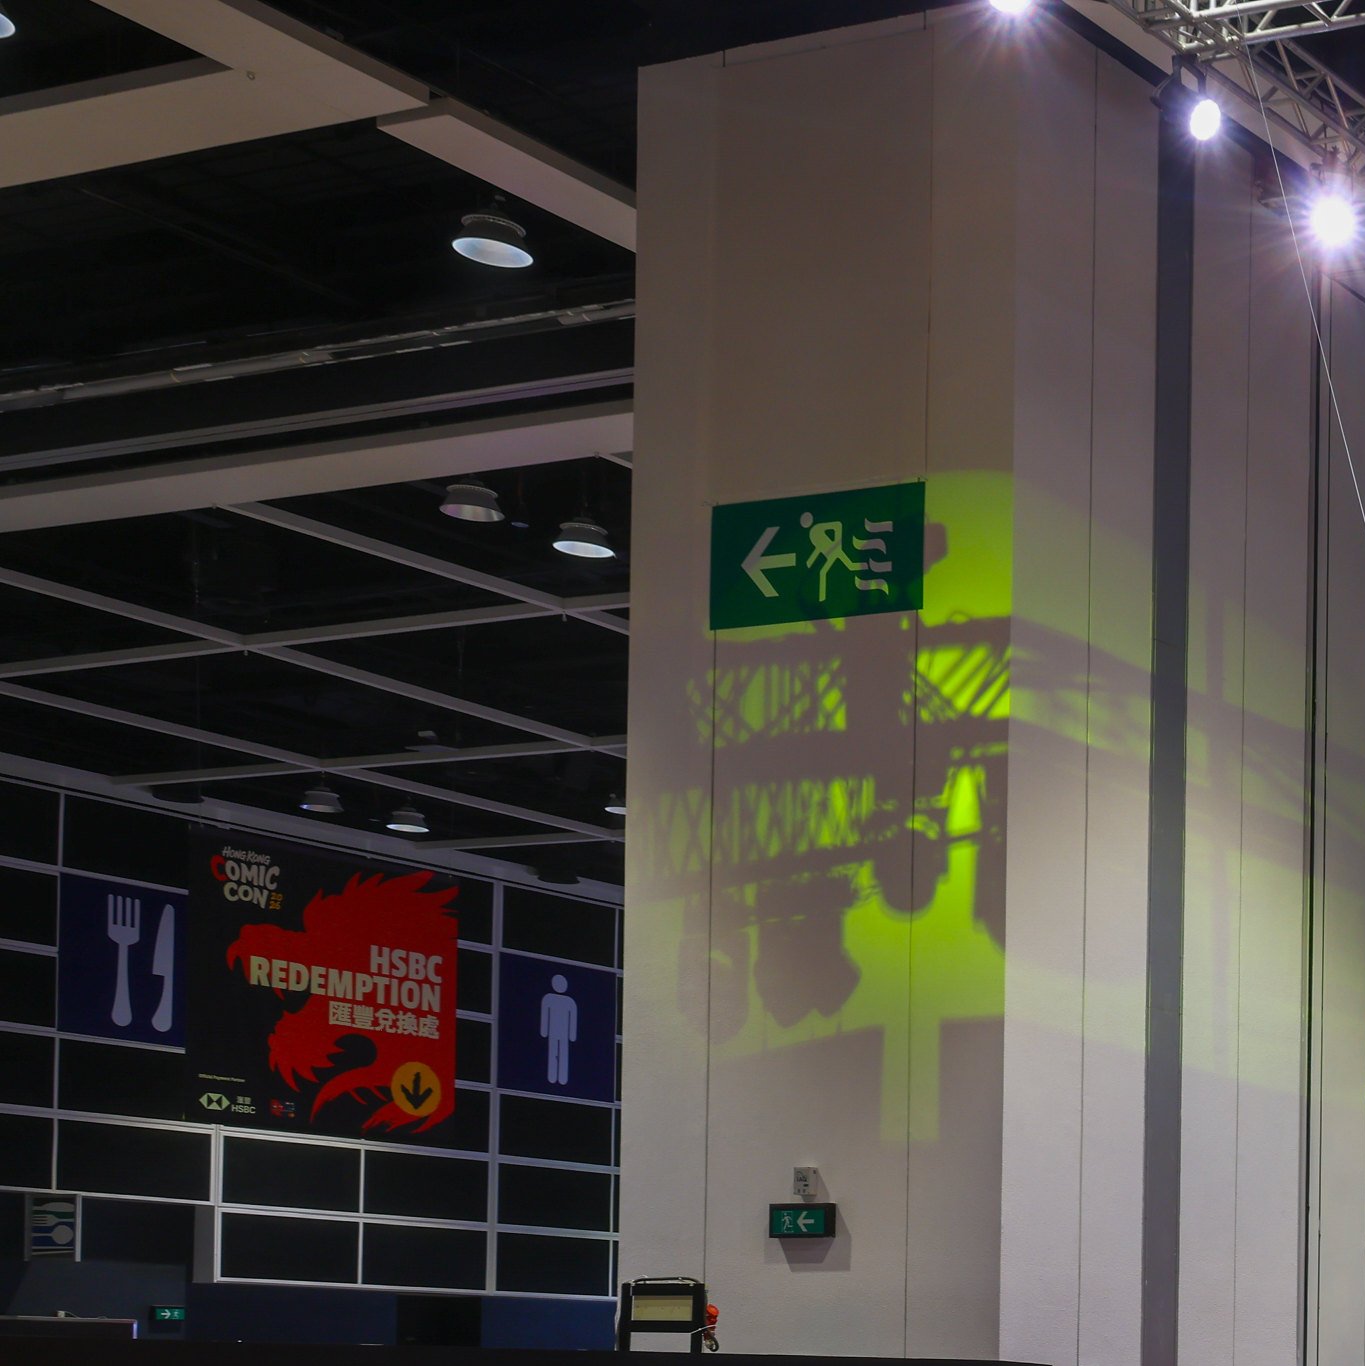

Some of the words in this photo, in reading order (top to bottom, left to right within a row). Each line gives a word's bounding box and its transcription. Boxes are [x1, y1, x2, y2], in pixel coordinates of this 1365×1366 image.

[210, 854, 280, 891] COMIC
[223, 881, 268, 909] CON
[370, 945, 443, 983] HSBC
[250, 955, 441, 1012] REDEMPTION
[231, 1104, 256, 1114] HSBC
